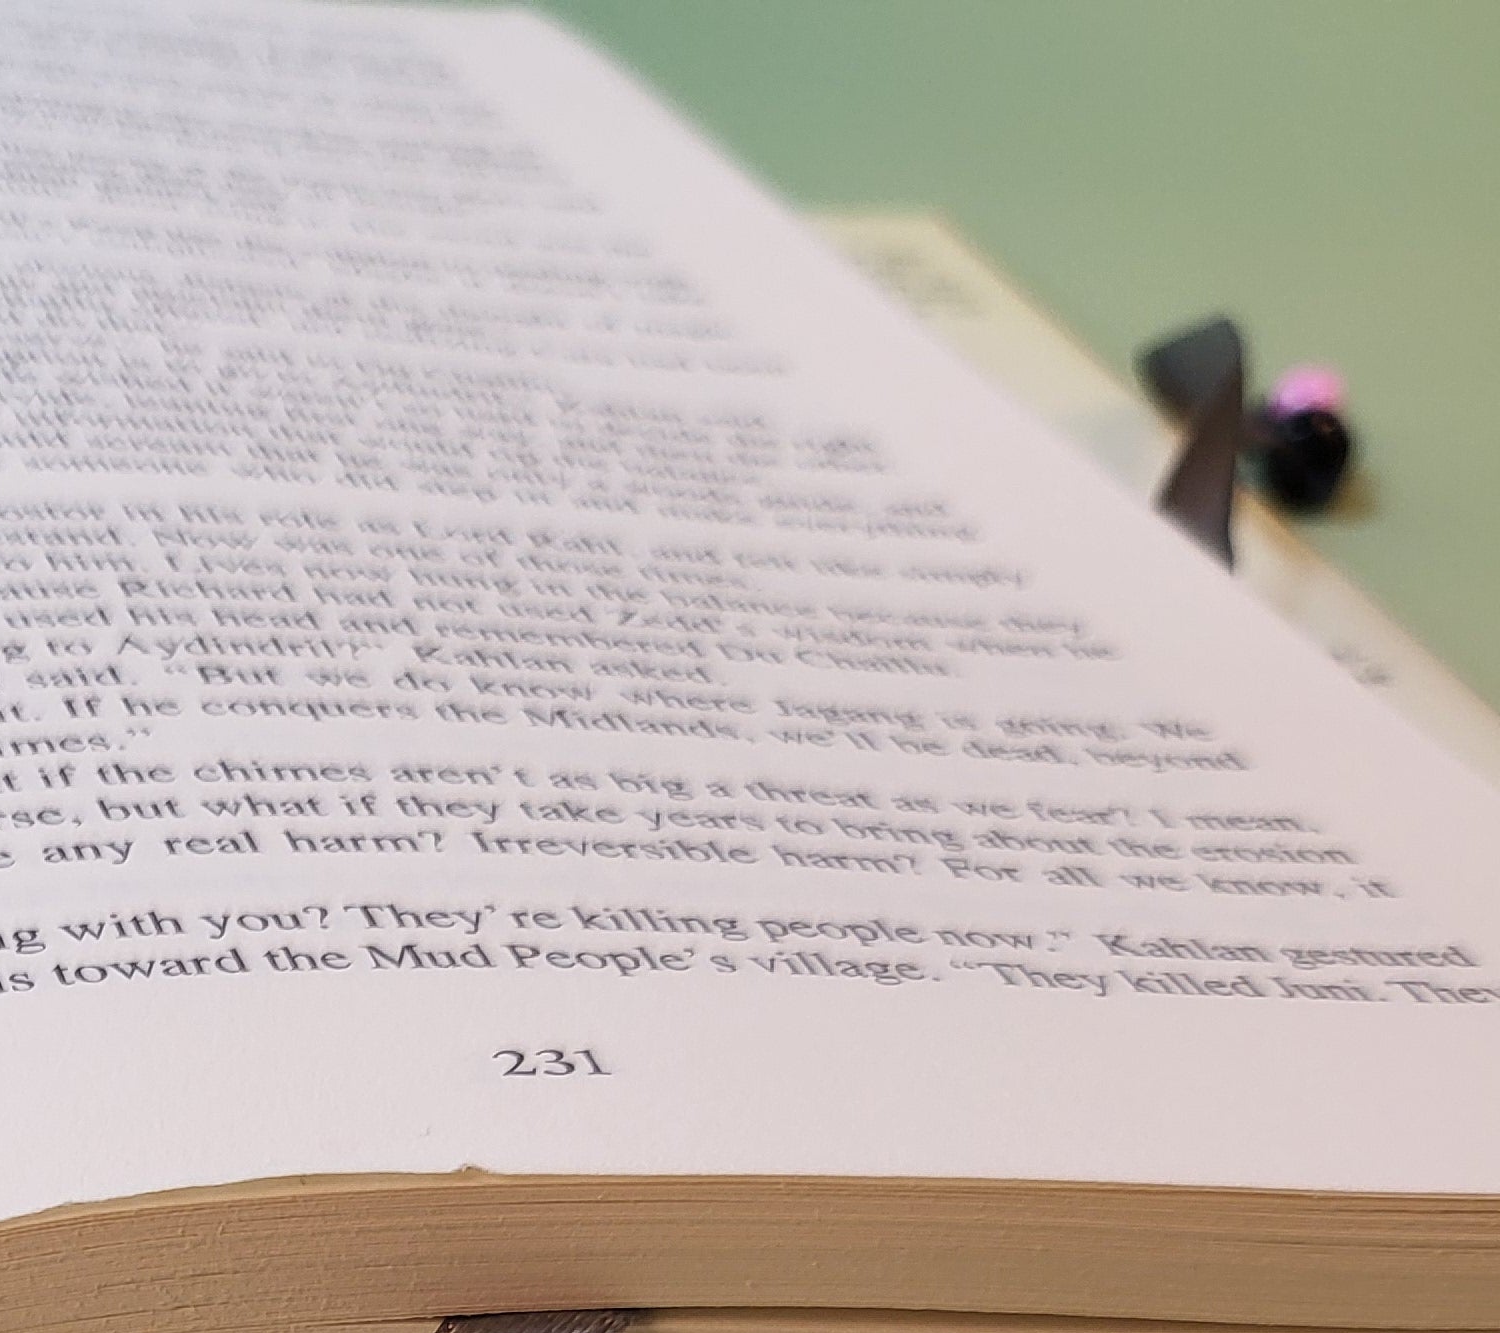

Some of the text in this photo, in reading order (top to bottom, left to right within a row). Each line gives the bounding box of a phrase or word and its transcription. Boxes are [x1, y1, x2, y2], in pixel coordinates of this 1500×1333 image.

[62, 695, 102, 718] If
[120, 695, 179, 717] he
[200, 698, 419, 723] conquers
[433, 700, 505, 724] the
[887, 734, 947, 756] be
[37, 763, 75, 789] if
[95, 761, 173, 785] the
[192, 758, 373, 783] chimes
[389, 765, 529, 787] aren’t
[548, 772, 599, 791] as
[607, 771, 694, 800] big
[705, 781, 733, 798] a
[742, 779, 878, 810] threat
[890, 795, 940, 815] as
[963, 801, 1018, 820] we
[96, 797, 180, 821] but
[200, 792, 322, 817] what
[339, 794, 379, 818] if
[395, 793, 501, 826] they
[518, 798, 620, 824] take
[637, 809, 766, 833] years
[774, 814, 826, 836] to
[830, 816, 967, 853] bring
[971, 828, 1097, 855] about
[1106, 836, 1183, 861] the
[1190, 841, 1357, 866] erosion
[41, 839, 134, 866] any
[162, 828, 260, 856] real
[282, 828, 444, 853] harm?
[470, 828, 759, 865] Irreversible
[770, 842, 919, 875] harm?
[938, 856, 1021, 883] For
[1042, 864, 1104, 888] all
[1118, 873, 1189, 893] we
[1194, 872, 1346, 900] know,
[59, 909, 185, 942] with
[200, 904, 330, 941] you?
[342, 902, 563, 936] They’re
[569, 904, 751, 943] killing
[755, 917, 927, 948] people
[1093, 932, 1273, 964] Kahlan
[1278, 944, 1480, 972] gestured
[51, 946, 251, 987] toward
[262, 944, 353, 973] the
[364, 942, 497, 970] Mud
[504, 942, 739, 978] People’s
[748, 949, 942, 987] village.
[948, 959, 1110, 999] “They
[1115, 968, 1269, 999] killed
[1268, 975, 1389, 1003] Juni.
[490, 1048, 613, 1078] 231
